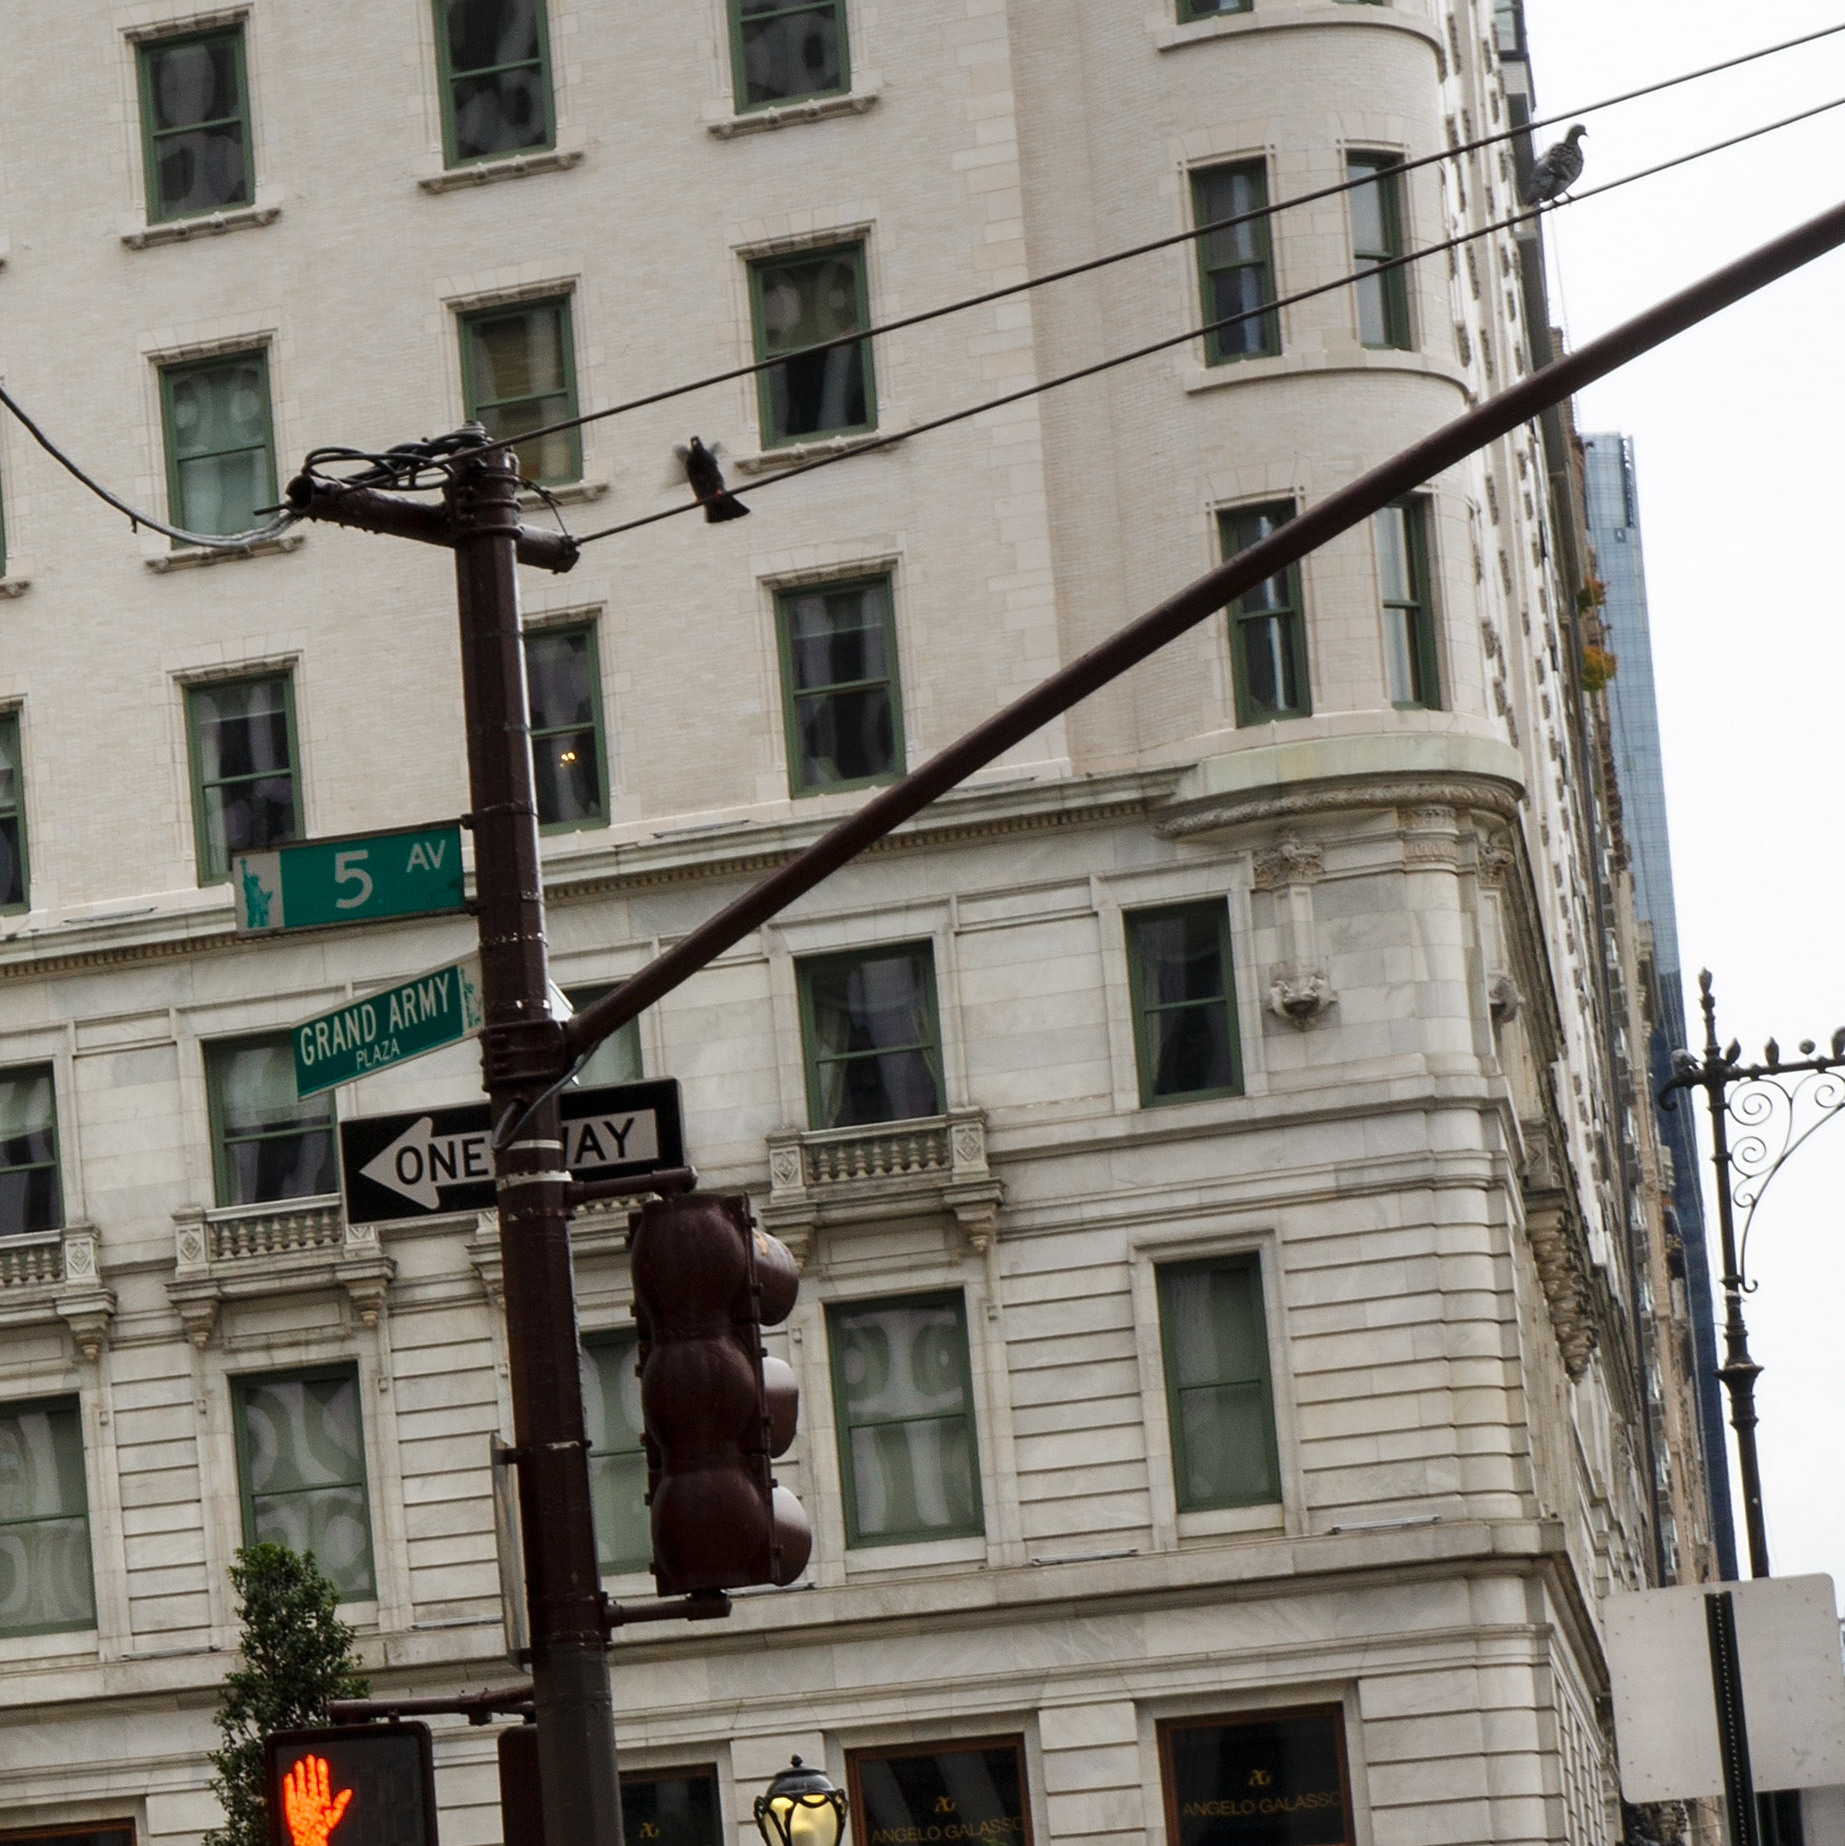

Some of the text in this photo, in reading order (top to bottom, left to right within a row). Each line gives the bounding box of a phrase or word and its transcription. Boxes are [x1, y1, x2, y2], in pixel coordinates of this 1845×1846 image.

[335, 839, 446, 909] 5 AV
[300, 972, 450, 1066] GRAND ARMY
[356, 1038, 400, 1070] PLAZA
[395, 1116, 635, 1185] ONE AY
[1184, 1792, 1341, 1817] ANGELO GALASSO
[871, 1816, 1023, 1844] ANGELO GALASSO
